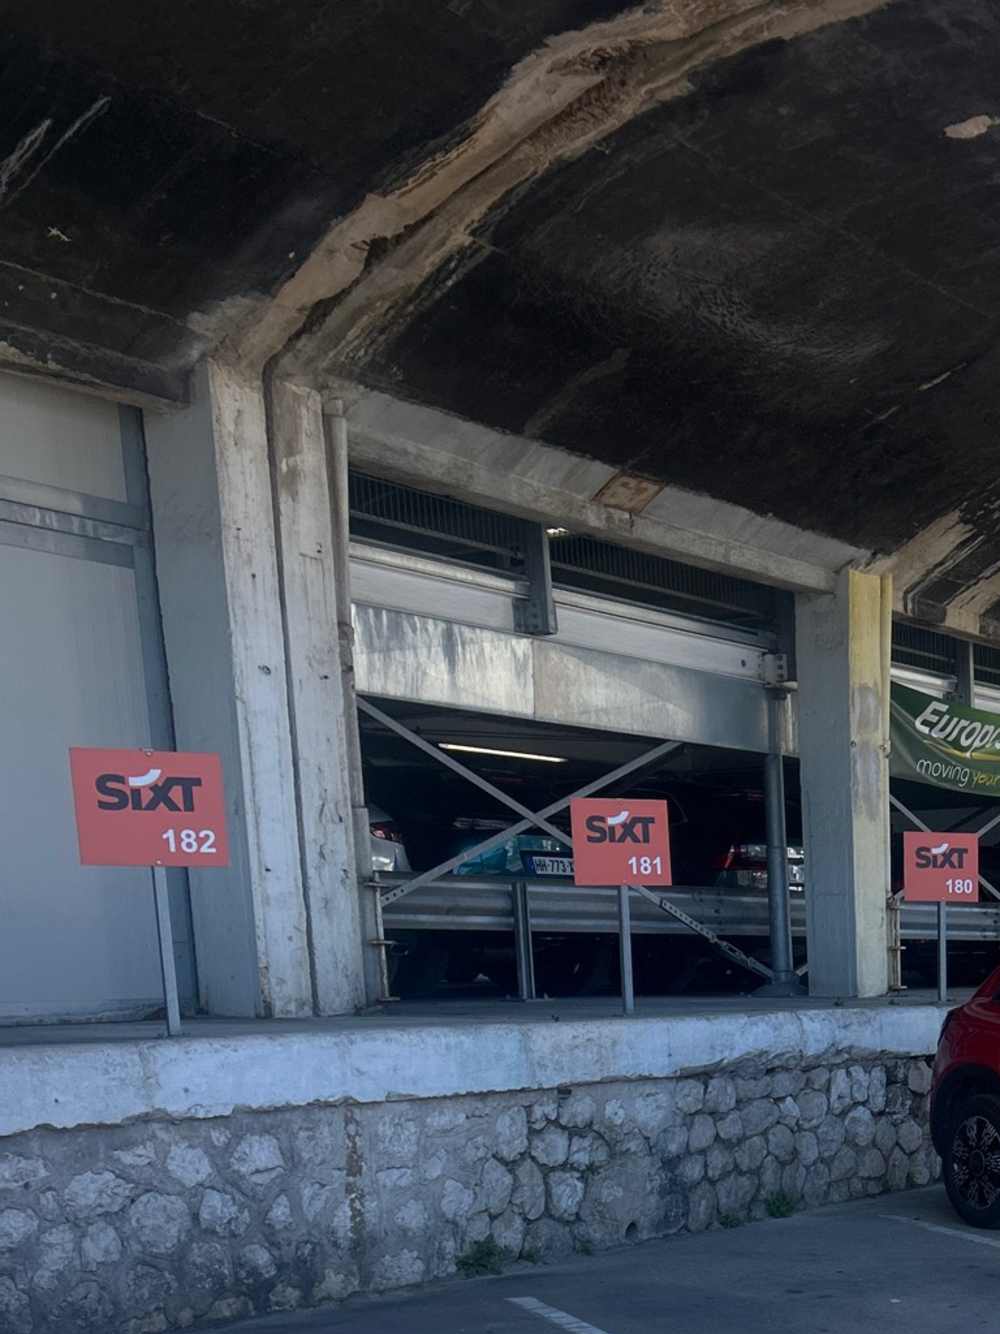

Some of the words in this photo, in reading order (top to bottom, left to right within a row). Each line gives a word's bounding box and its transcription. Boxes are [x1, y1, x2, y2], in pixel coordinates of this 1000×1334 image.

[916, 759, 970, 787] moving
[162, 829, 217, 853] 182
[628, 856, 662, 875] 181
[945, 879, 973, 894] 180
